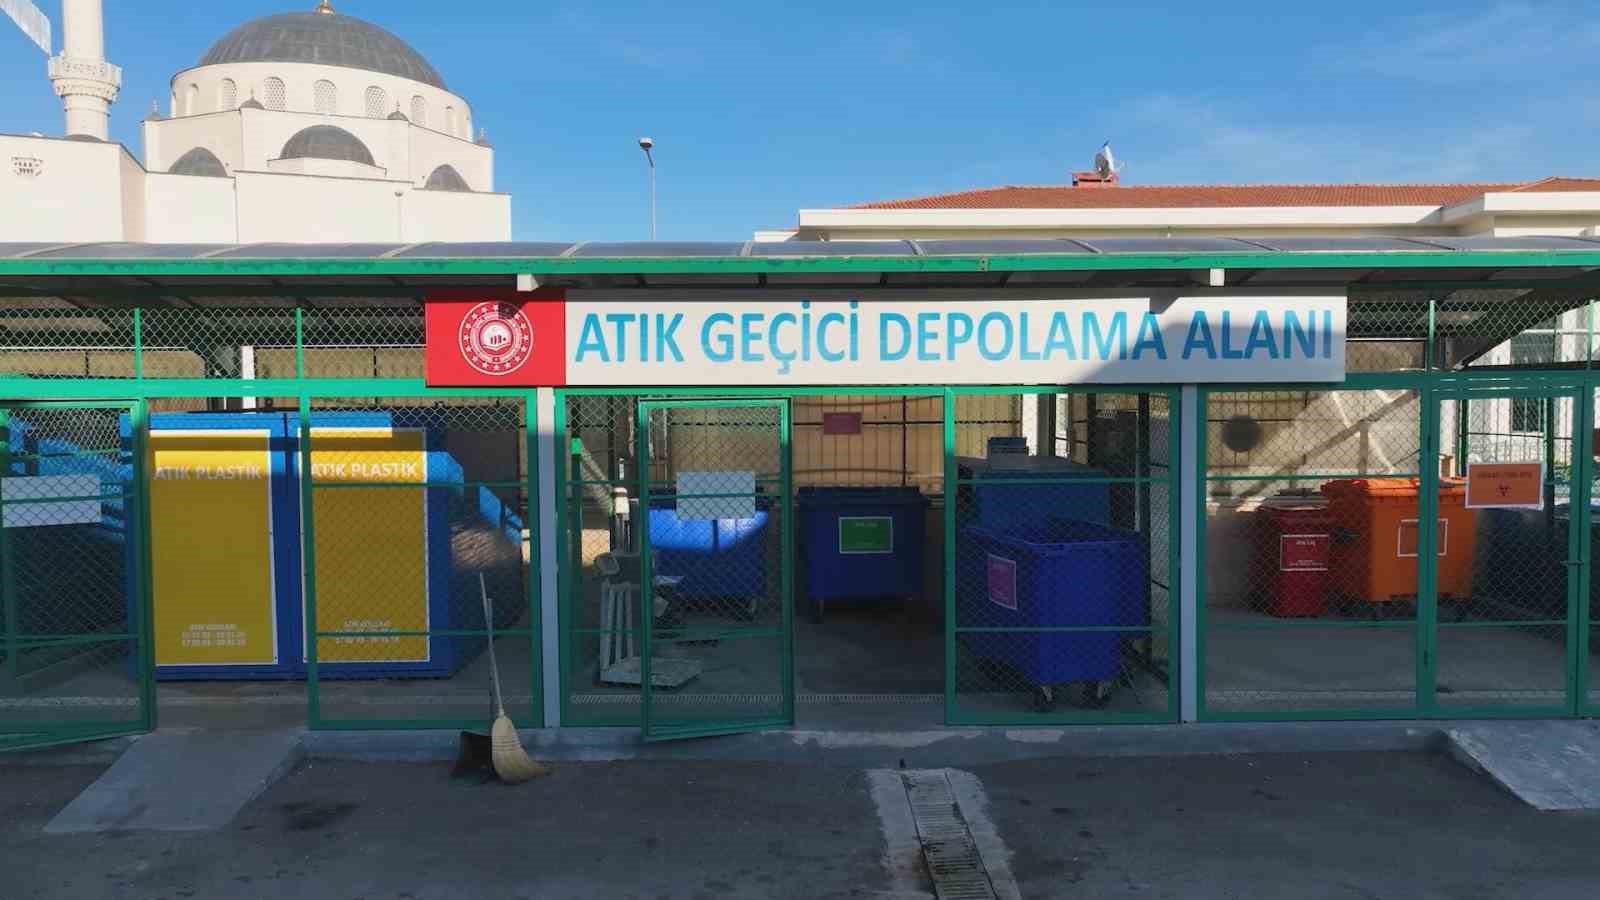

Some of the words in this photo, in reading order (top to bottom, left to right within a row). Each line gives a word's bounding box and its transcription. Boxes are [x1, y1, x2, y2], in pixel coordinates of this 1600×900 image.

[575, 313, 685, 362] ATIK
[700, 300, 859, 375] GEÇİCİ
[879, 311, 1167, 361] DEPOLAMA
[1181, 309, 1332, 360] ALANI
[154, 465, 191, 480] ATIK
[196, 463, 261, 480] PLASTİK
[310, 463, 344, 478] ATIK
[351, 460, 417, 478] PLASTİK
